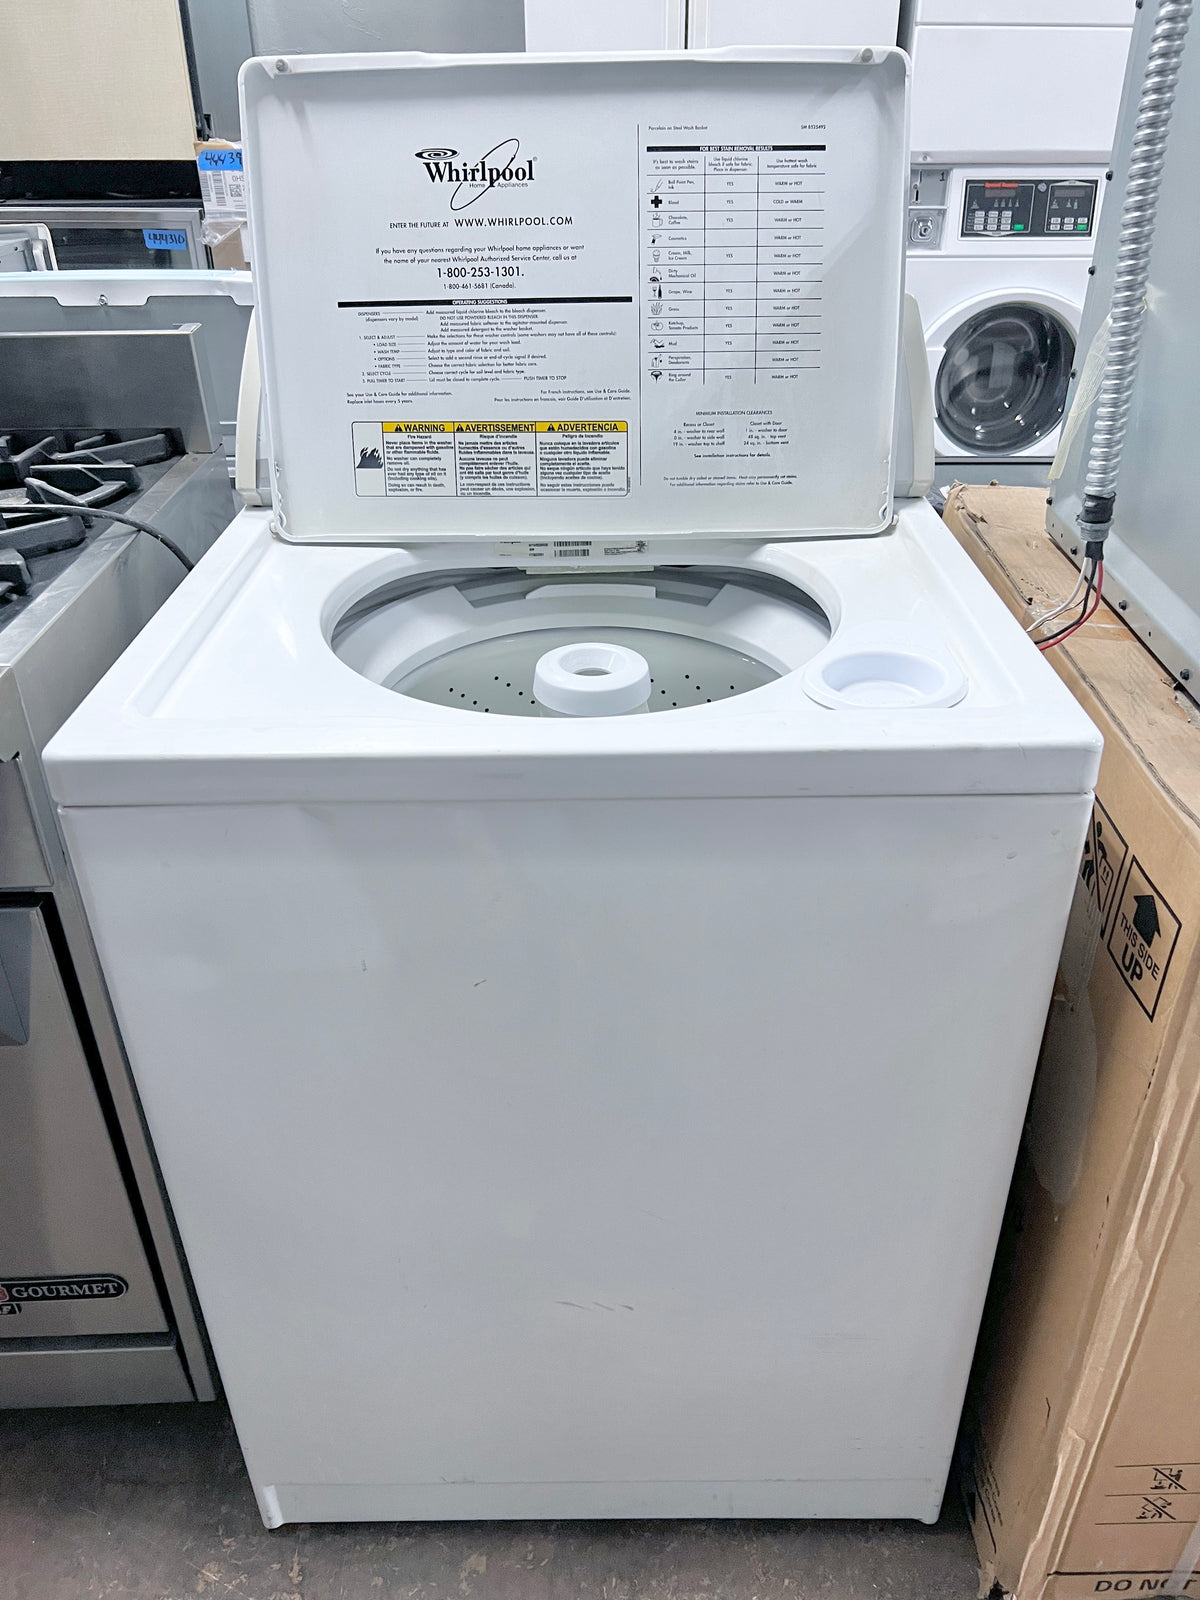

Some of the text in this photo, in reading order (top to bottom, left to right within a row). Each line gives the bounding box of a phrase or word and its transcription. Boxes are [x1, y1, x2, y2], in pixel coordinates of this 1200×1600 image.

[422, 160, 535, 187] Whirlpool
[454, 216, 573, 228] WWW.WHIRLPOOL.COM
[148, 233, 185, 245] 444310
[437, 266, 525, 278] 1-800-253-1301.
[404, 424, 445, 432] WARNING
[465, 424, 534, 432] AVERTISSEMENT
[1120, 912, 1160, 981] THIS SIDE
[1122, 943, 1143, 981] UP
[11, 1282, 118, 1297] GOURMET
[1094, 1579, 1132, 1592] DO
